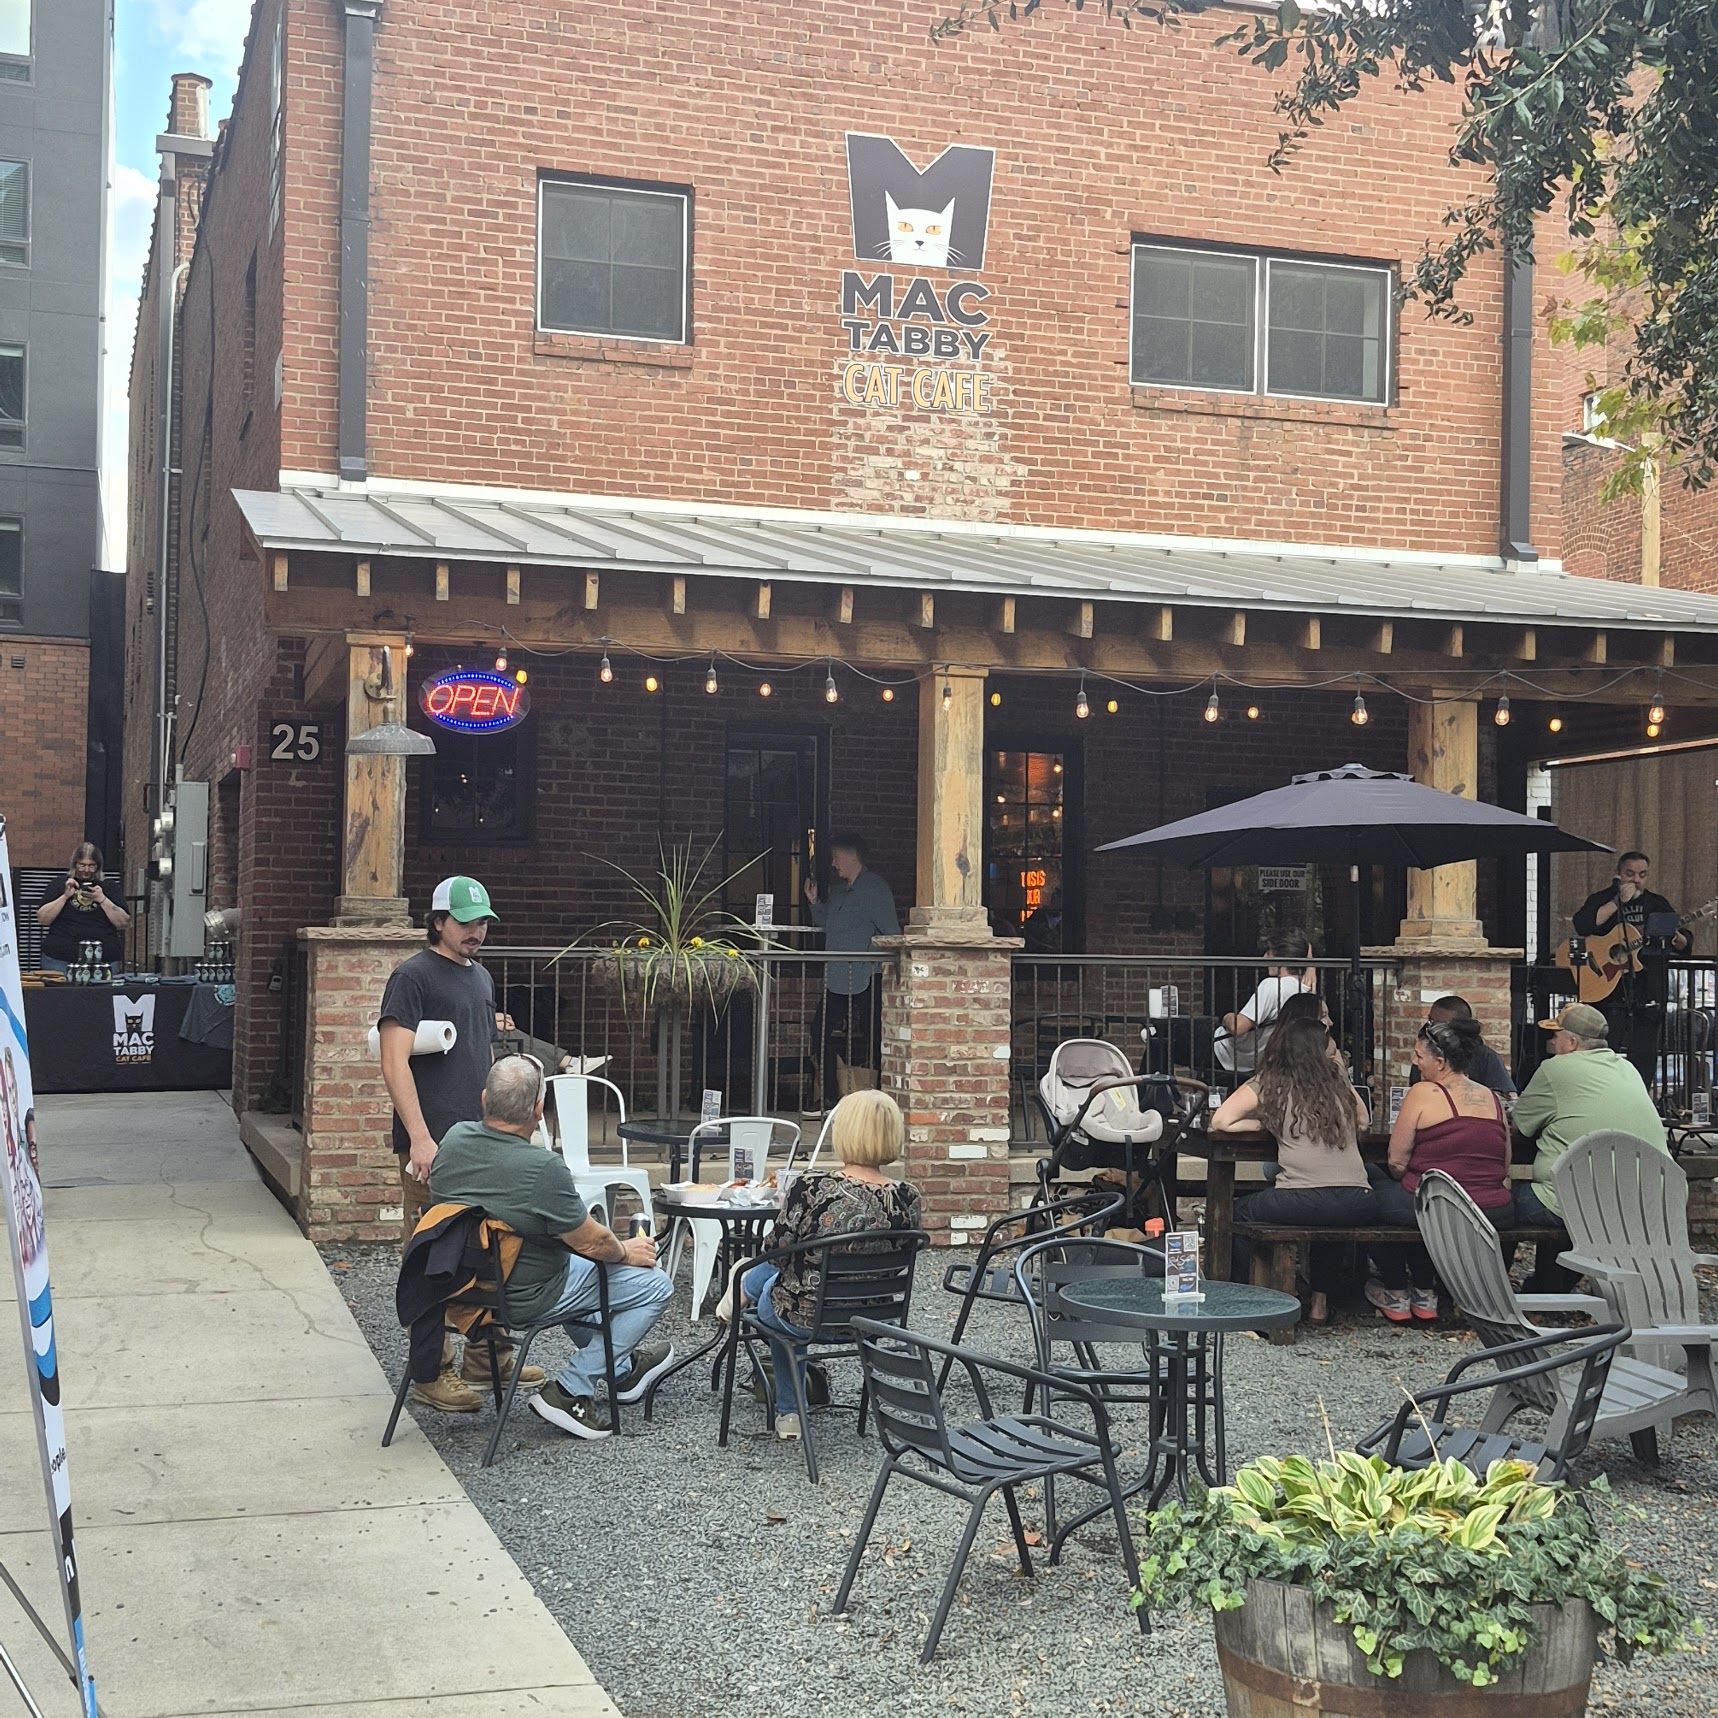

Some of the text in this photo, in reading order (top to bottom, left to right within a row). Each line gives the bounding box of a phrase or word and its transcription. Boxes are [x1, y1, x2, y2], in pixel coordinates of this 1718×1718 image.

[841, 270, 992, 326] MAC
[841, 319, 992, 361] TABBY
[844, 362, 990, 413] CAT CAFE
[428, 684, 519, 716] OPEN
[271, 723, 320, 761] 25
[1259, 869, 1279, 877] PLEASE
[1262, 879, 1299, 888] SIDE DOOR
[113, 1032, 154, 1046] MAC
[113, 1046, 154, 1056] TABBY
